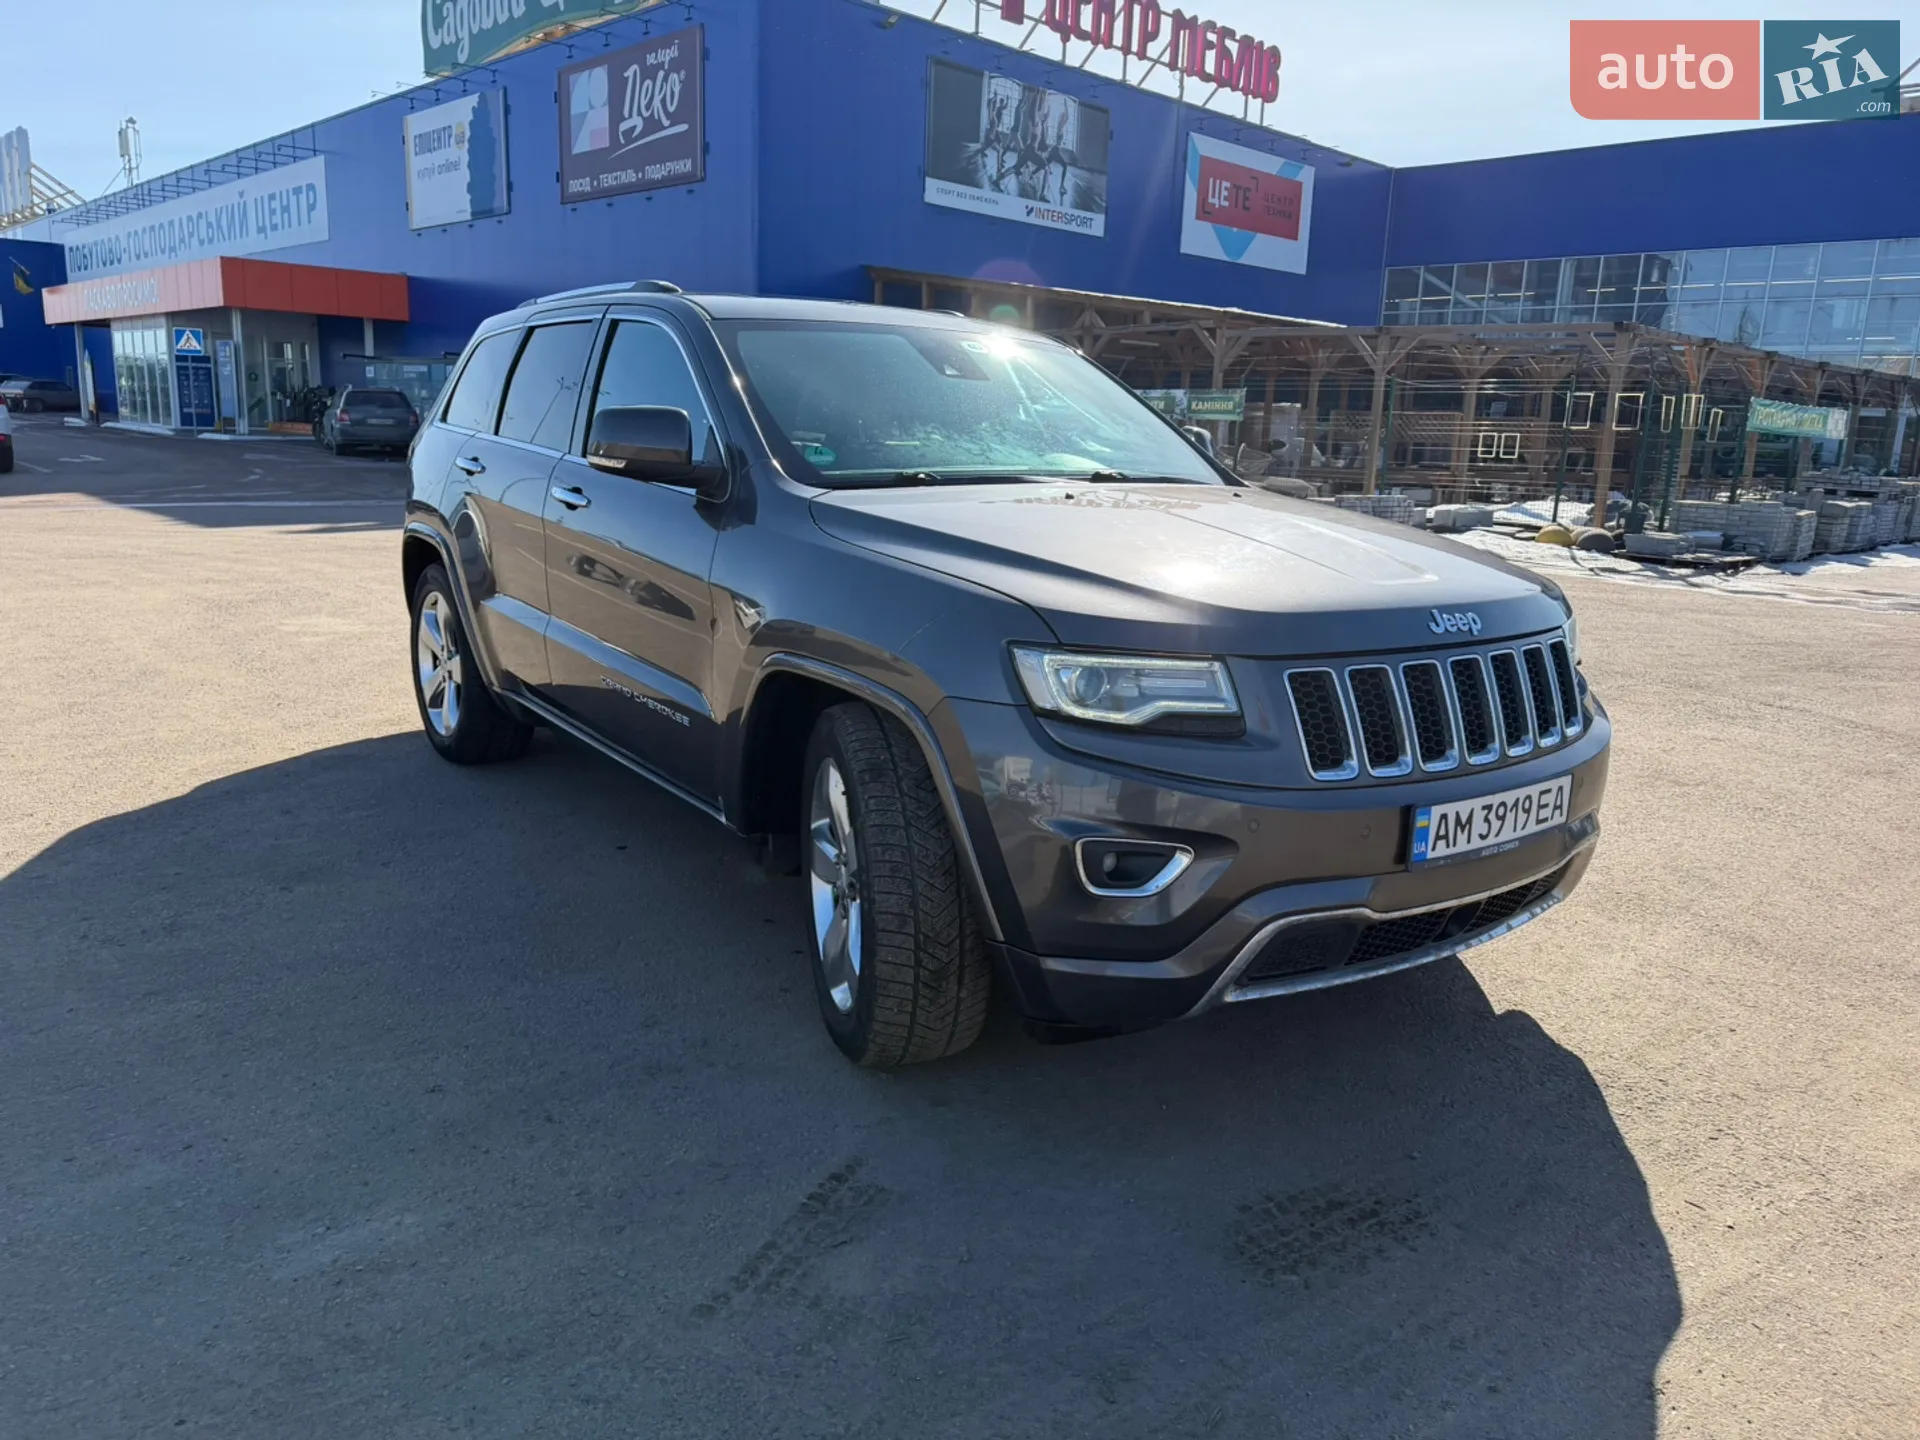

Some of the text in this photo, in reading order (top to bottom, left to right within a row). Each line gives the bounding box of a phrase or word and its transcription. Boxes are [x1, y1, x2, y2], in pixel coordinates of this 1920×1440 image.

[1168, 8, 1282, 103] МЕБЛІВ
[568, 158, 692, 193] ПОСУД ТЕКСТИЛЬ ПОДАРУНКИ
[68, 182, 318, 274] ПОБУТОВО-ГОСПОДАРСЬКИЙ ЦЕНТР
[1034, 206, 1094, 230] INTERSPORT
[1190, 401, 1235, 411] КАМІННЯ
[1428, 609, 1482, 636] Jeep
[633, 691, 691, 727] CHEROKEE
[1414, 841, 1427, 854] UA
